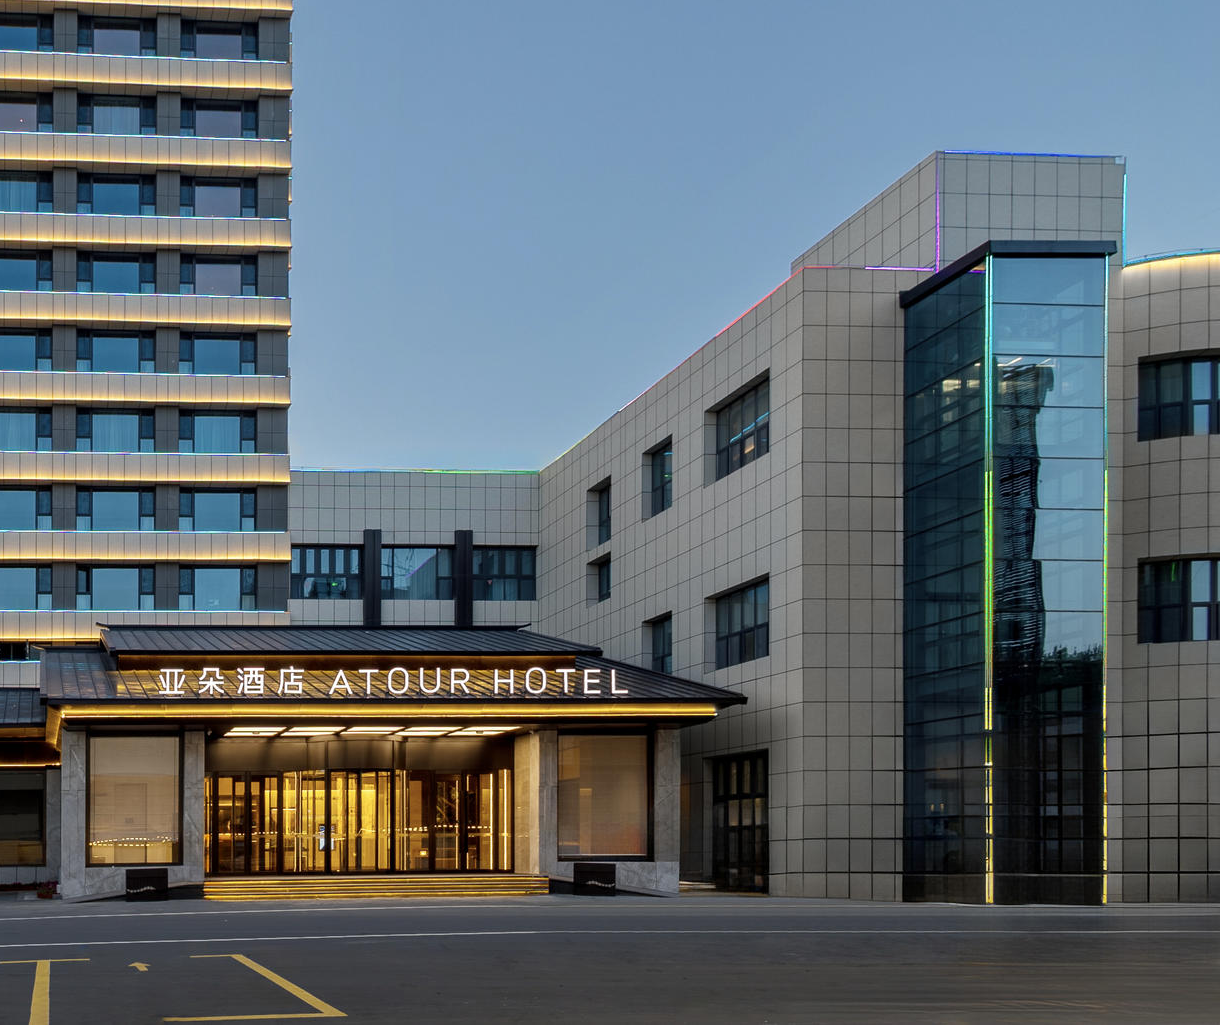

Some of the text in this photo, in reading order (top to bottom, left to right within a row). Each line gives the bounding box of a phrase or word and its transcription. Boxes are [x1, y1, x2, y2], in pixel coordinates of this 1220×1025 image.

[158, 666, 628, 695] 亚朵酒店 ATOUR HOTEL
